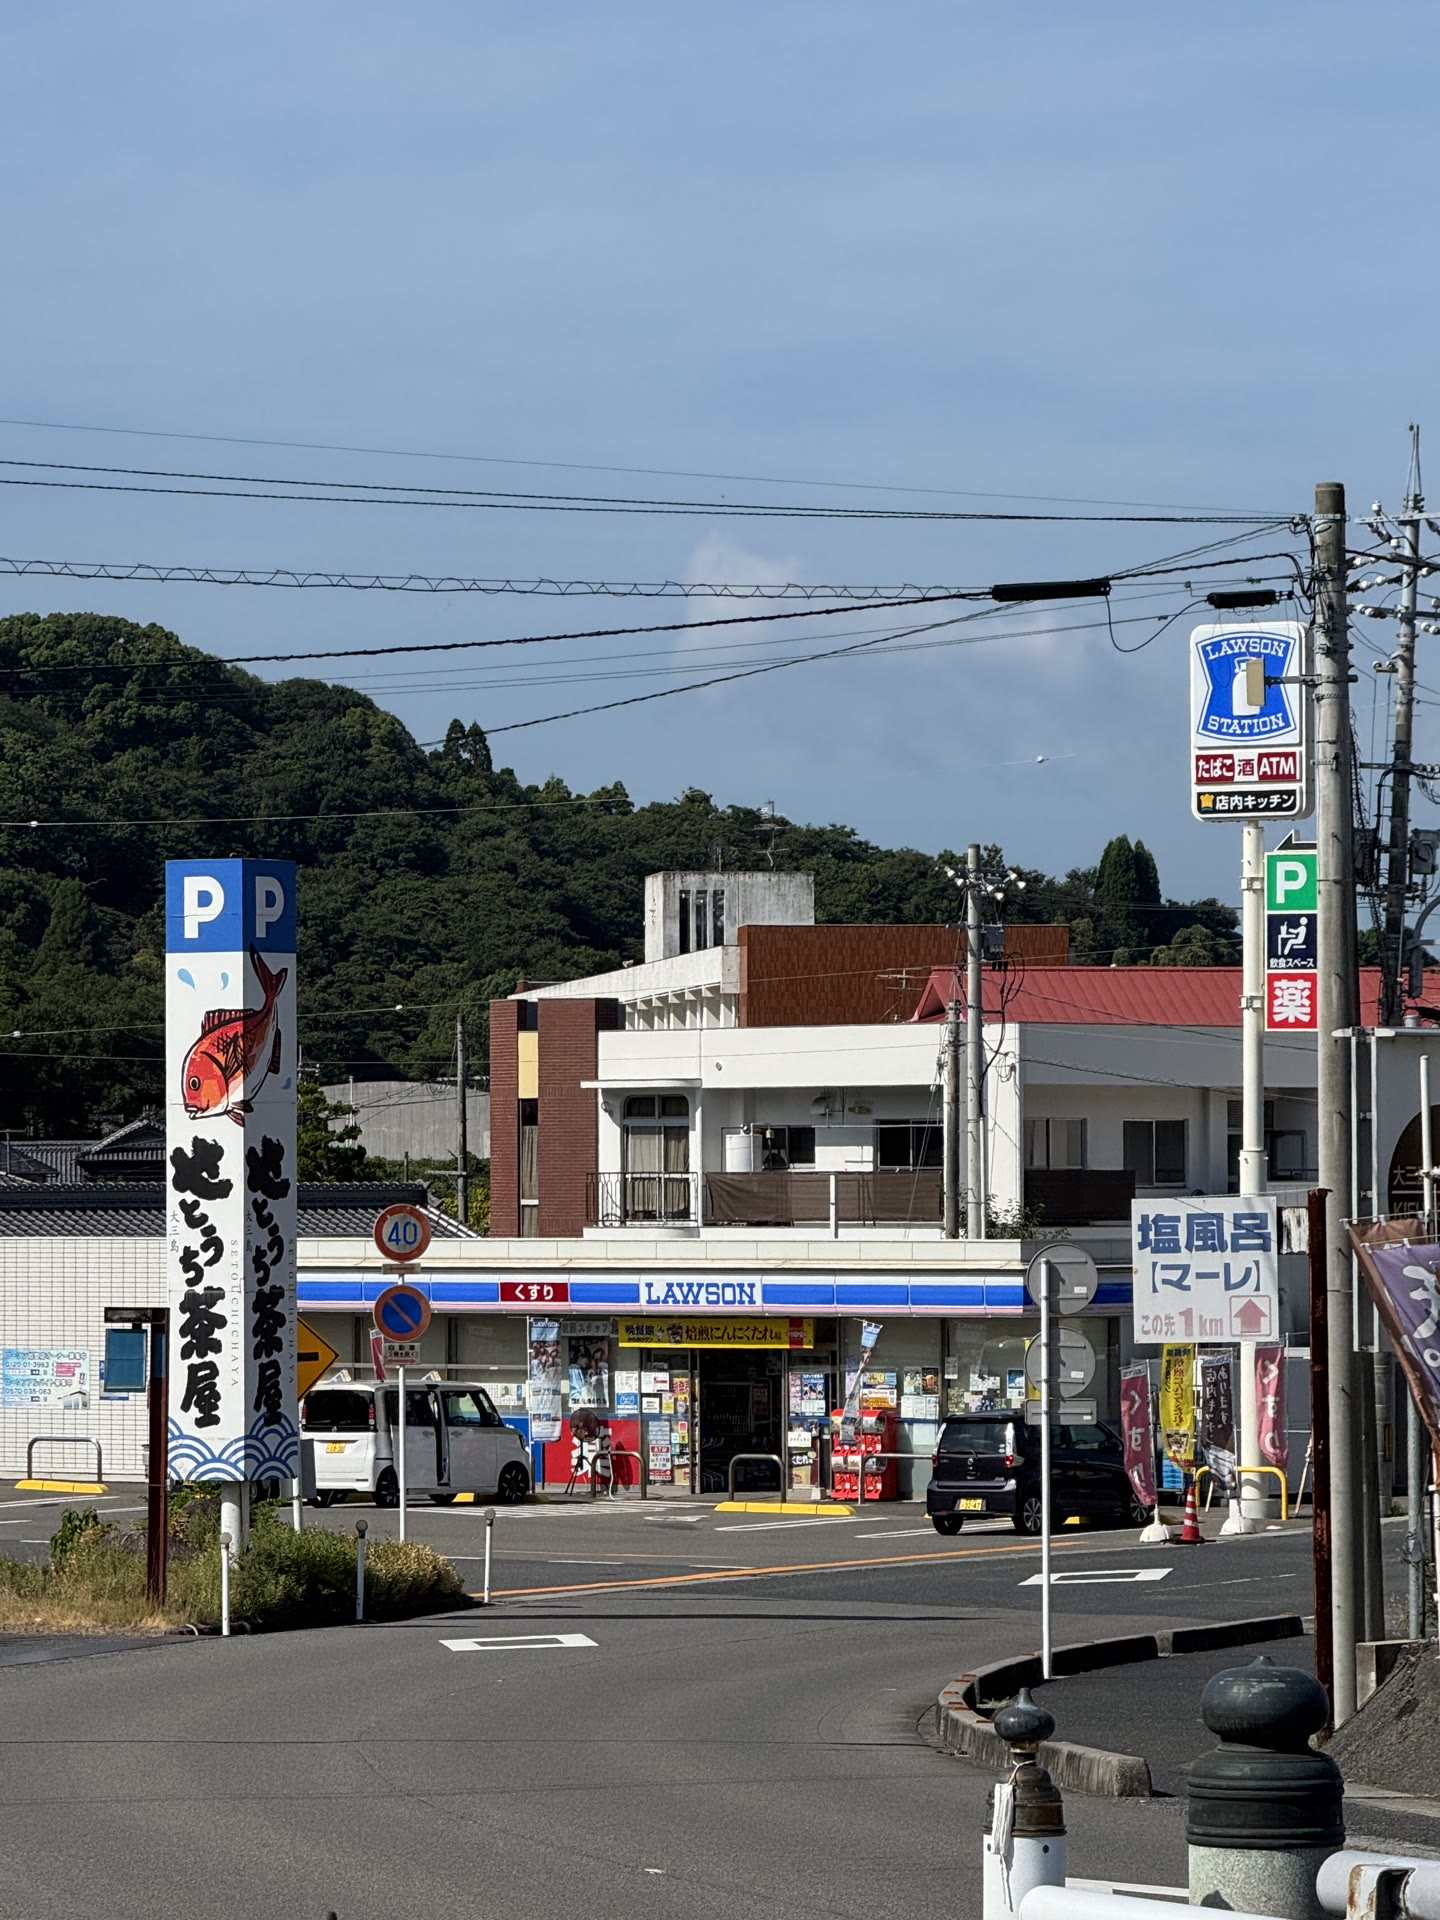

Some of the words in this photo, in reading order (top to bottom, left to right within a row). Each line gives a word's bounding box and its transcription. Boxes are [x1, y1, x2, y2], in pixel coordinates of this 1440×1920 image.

[1206, 638, 1286, 660] LAWSON
[1207, 713, 1285, 734] STATION
[1197, 759, 1234, 778] たばこ
[1237, 759, 1254, 776] 酒
[1259, 757, 1295, 776] ATM
[1215, 794, 1294, 811] 店内キッチン
[1276, 861, 1307, 903] P
[184, 876, 225, 939] P
[255, 875, 285, 938] P
[1269, 958, 1314, 968] 飲食スペース
[1272, 979, 1312, 1023] 薬
[170, 1211, 179, 1253] 大三島
[388, 1221, 418, 1245] 40
[1137, 1212, 1272, 1255] 塩風呂
[170, 1135, 234, 1429] せとうち茶屋
[246, 1135, 291, 1427] せとうち茶屋
[514, 1284, 554, 1301] くすり
[645, 1282, 757, 1305] LAWSON
